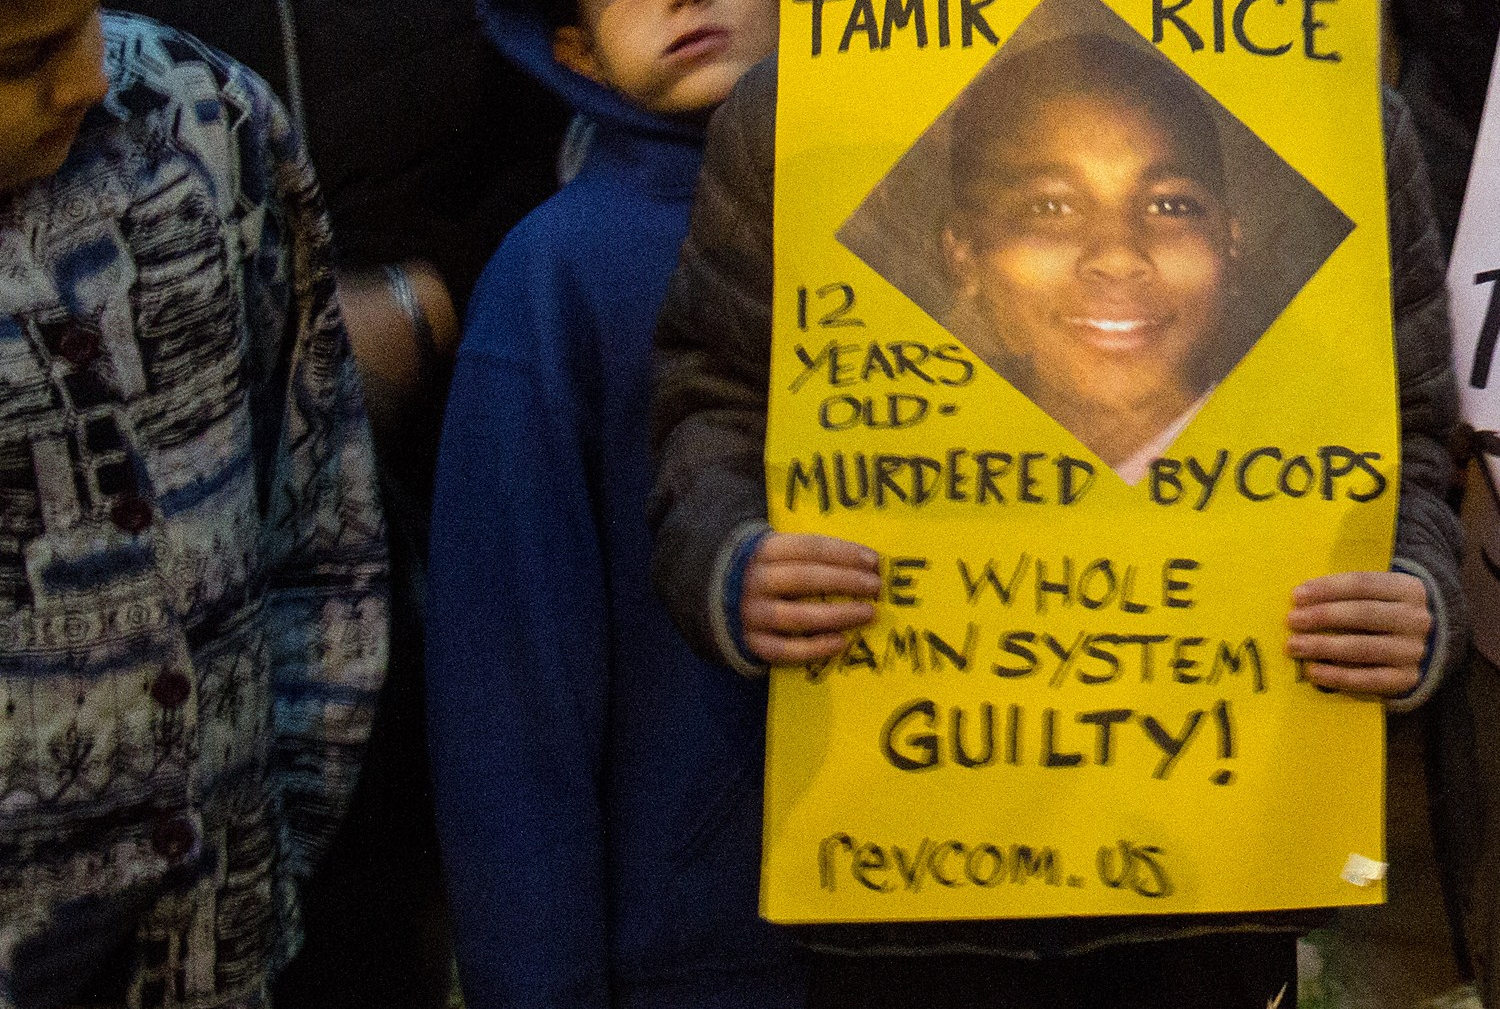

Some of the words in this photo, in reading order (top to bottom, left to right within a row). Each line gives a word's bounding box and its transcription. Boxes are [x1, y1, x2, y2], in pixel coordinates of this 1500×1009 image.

[795, 281, 866, 332] 12
[788, 337, 976, 393] YEARS
[785, 448, 1097, 514] MURDERED
[1148, 448, 1229, 511] BY
[1236, 445, 1387, 505] COPS
[956, 552, 1200, 615] WHOLE
[805, 621, 979, 683] AMN
[991, 630, 1268, 694] SYSTEM
[878, 698, 1240, 786] GUILTY!
